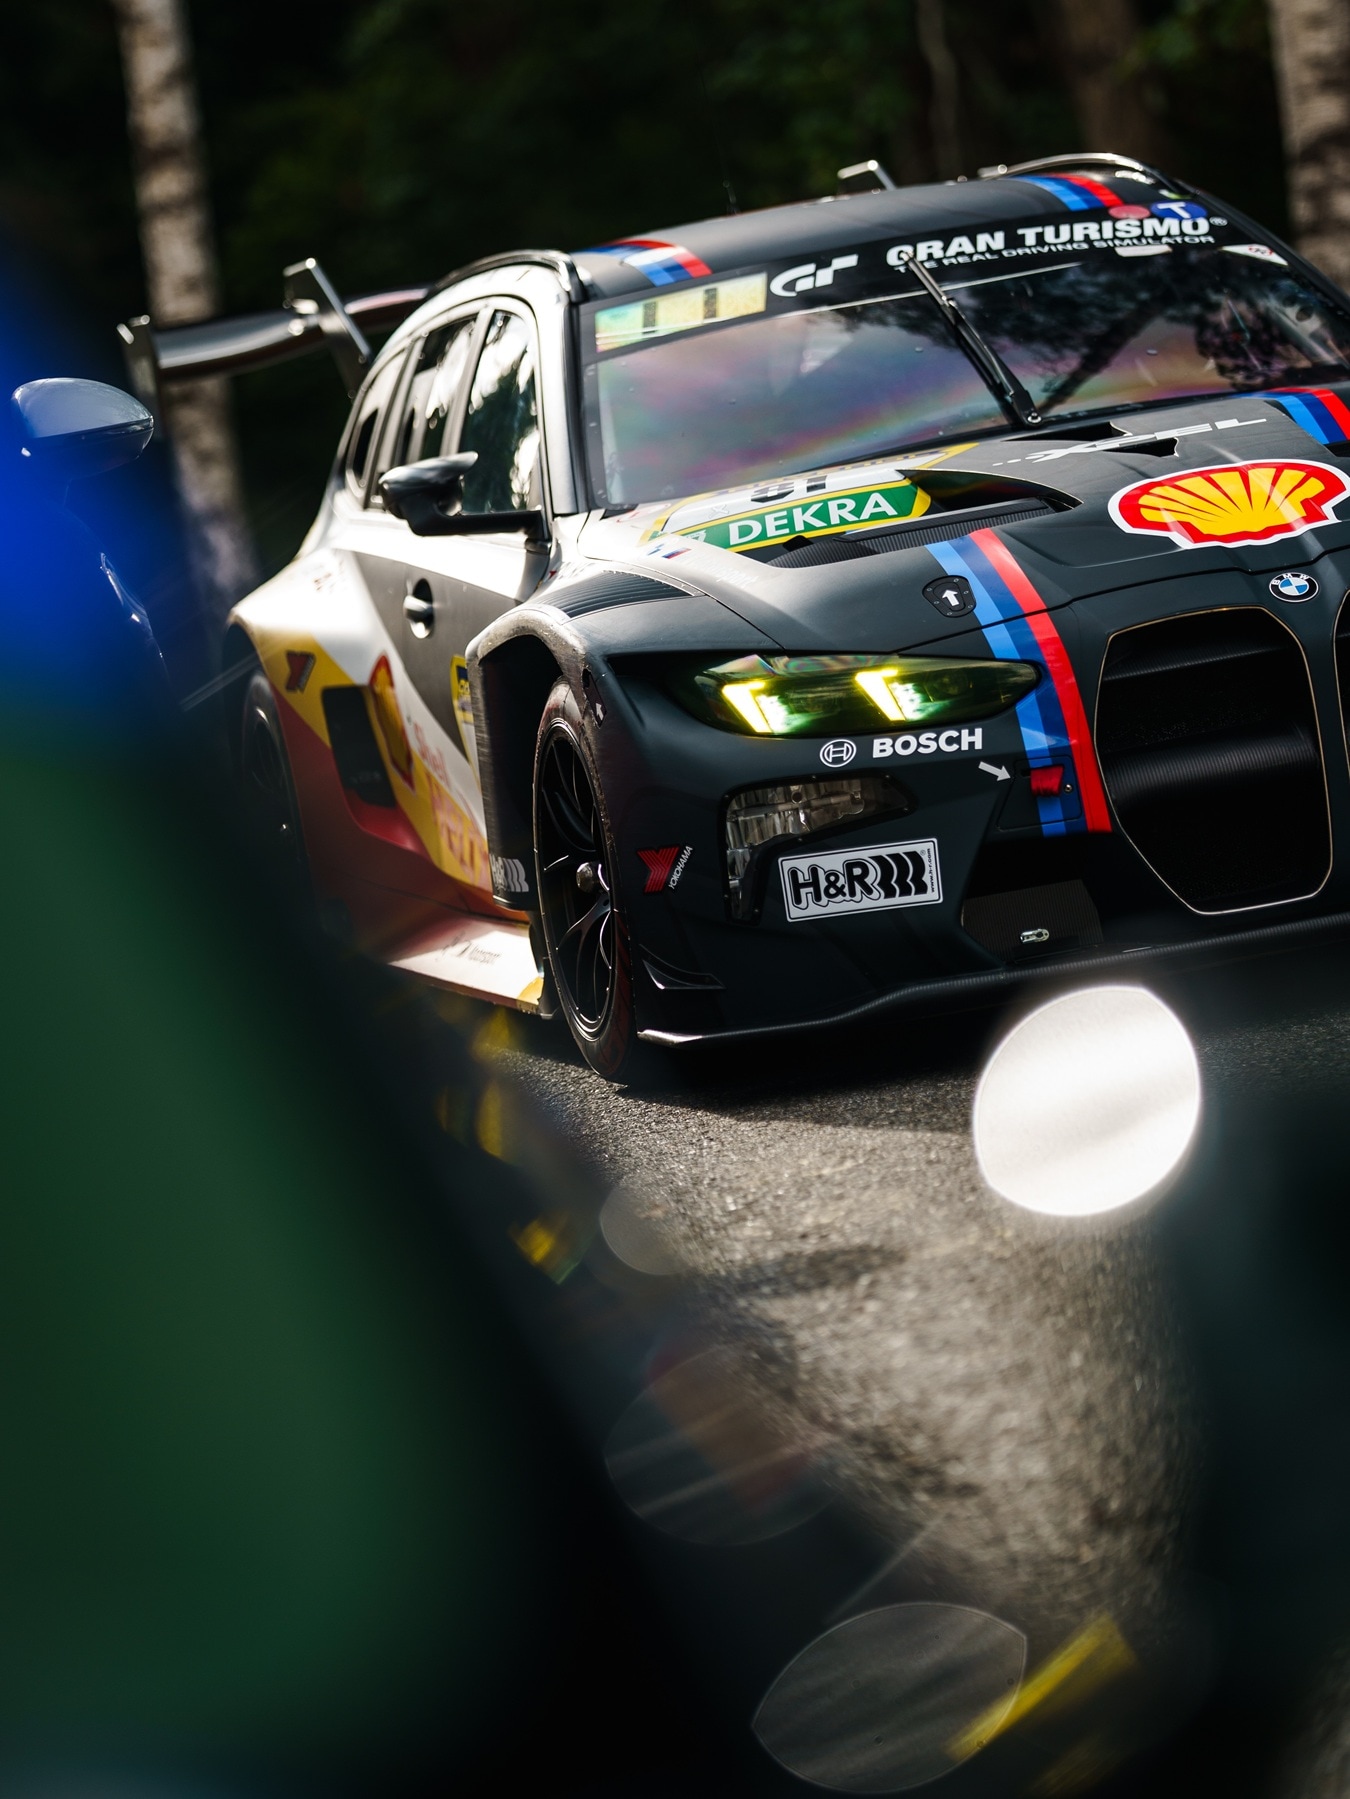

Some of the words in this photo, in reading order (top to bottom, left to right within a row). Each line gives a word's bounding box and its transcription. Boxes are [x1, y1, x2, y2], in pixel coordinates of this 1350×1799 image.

[886, 231, 1005, 267] GRAN
[894, 261, 939, 274] TE
[942, 252, 999, 266] REAL
[1001, 242, 1089, 258] DRIVING
[1093, 235, 1216, 252] SIMULATOR
[729, 492, 898, 546] DEKRA
[872, 728, 983, 758] BOSCH
[668, 845, 693, 890] YOKOHAMA
[789, 859, 880, 910] H&R
